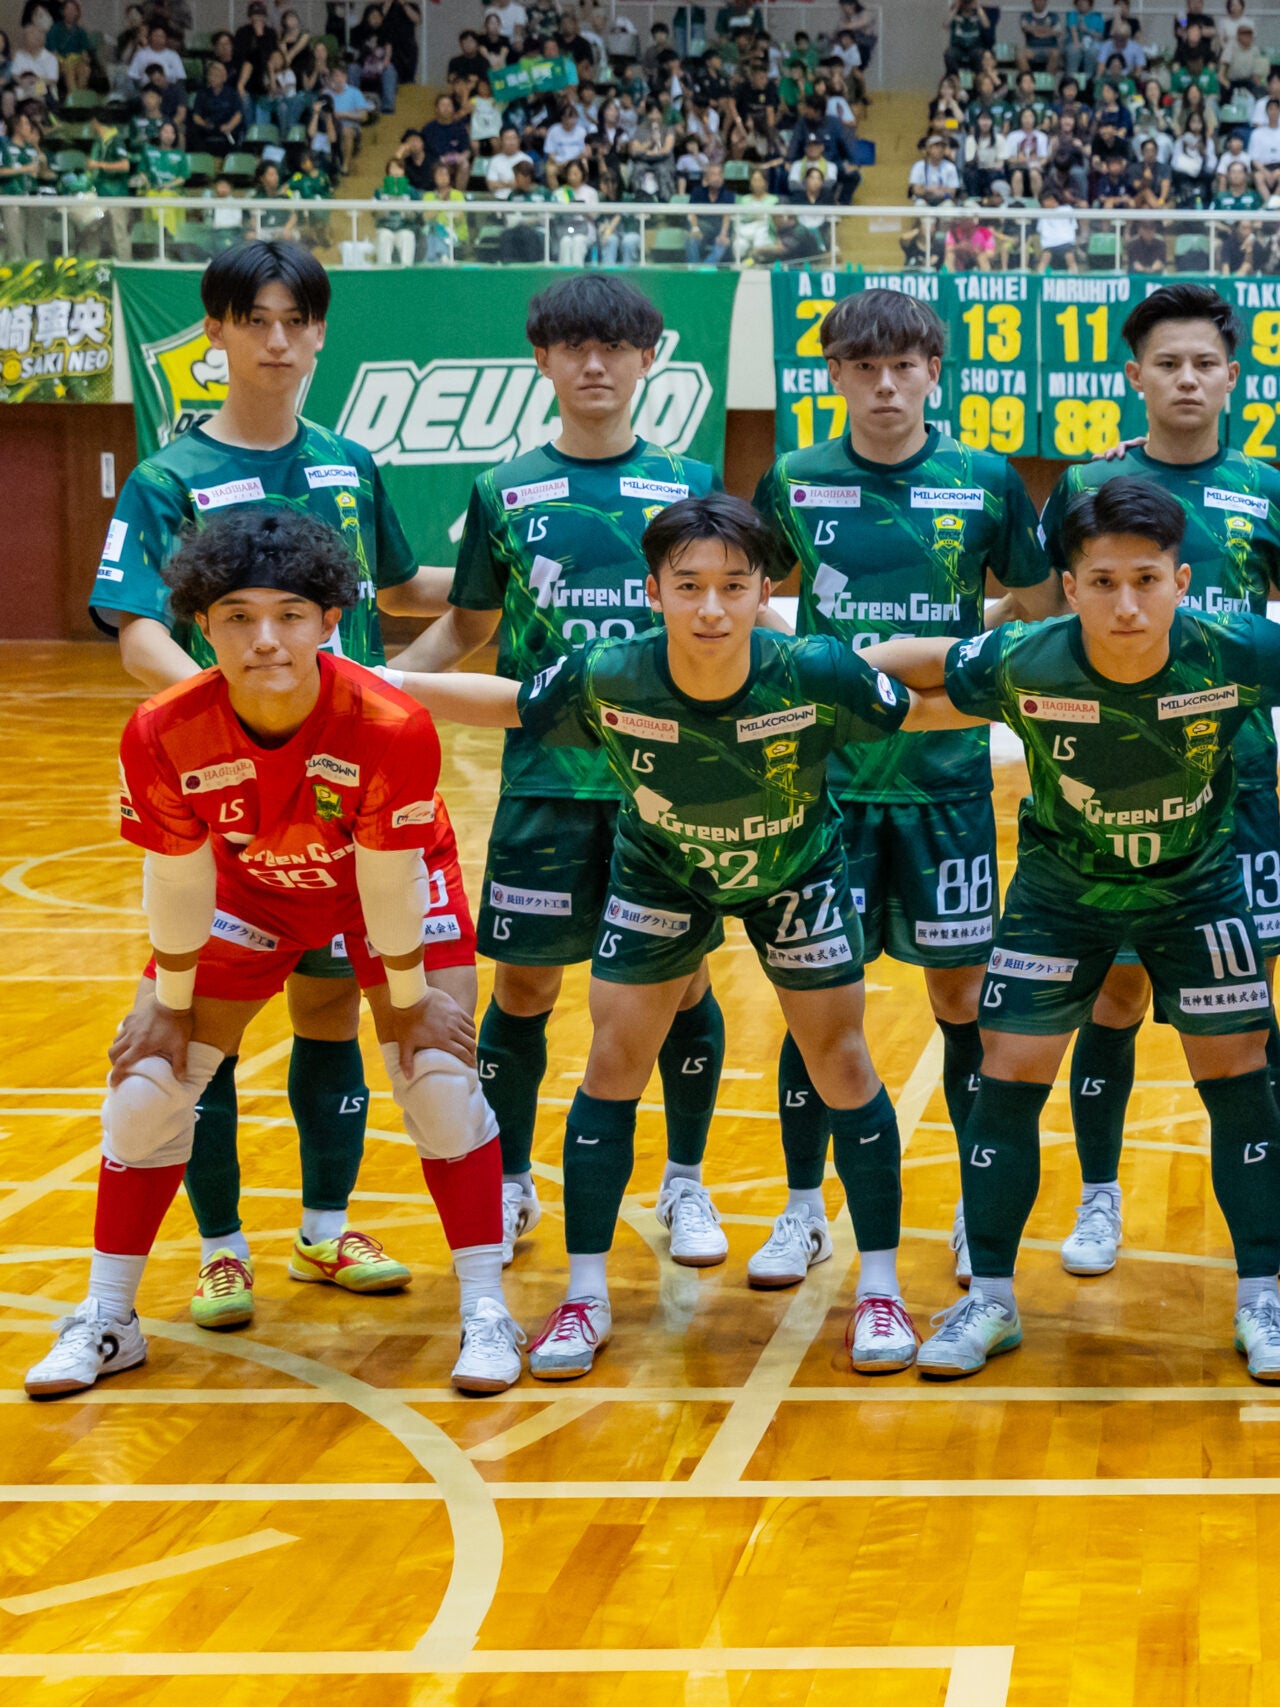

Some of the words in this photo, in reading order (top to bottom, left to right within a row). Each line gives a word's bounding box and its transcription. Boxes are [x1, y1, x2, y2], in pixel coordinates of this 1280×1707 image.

[954, 275, 1028, 302] TAIHEI
[1042, 278, 1130, 303] HARUHITO
[963, 303, 1022, 362] 13
[1055, 305, 1108, 362] 11
[68, 348, 109, 372] NEO
[960, 368, 1027, 394] SHOTA
[1048, 372, 1127, 398] MIKIYA
[338, 330, 713, 464] DEUO
[791, 395, 848, 449] 17
[959, 395, 1025, 453] 99
[1054, 399, 1121, 455] 88
[308, 469, 357, 479] MILKCROWN
[622, 481, 687, 495] MILKCROWN
[810, 489, 858, 499] HAGIHARA
[913, 491, 982, 501] MILKCROWN
[1206, 491, 1268, 510] MILKCROWN
[910, 593, 960, 621] Gard
[1042, 700, 1096, 713] HAGIHARA
[1161, 689, 1236, 711] MILKCROWN
[622, 715, 675, 734] HAGIHARA
[740, 709, 814, 733] MILKCROWN
[204, 762, 253, 782] HAGIHARA
[743, 805, 805, 841] Gard
[1106, 832, 1161, 868] 10
[679, 842, 759, 890] 22
[936, 854, 993, 915] 88
[767, 878, 844, 944] 22
[1195, 917, 1258, 979] 10
